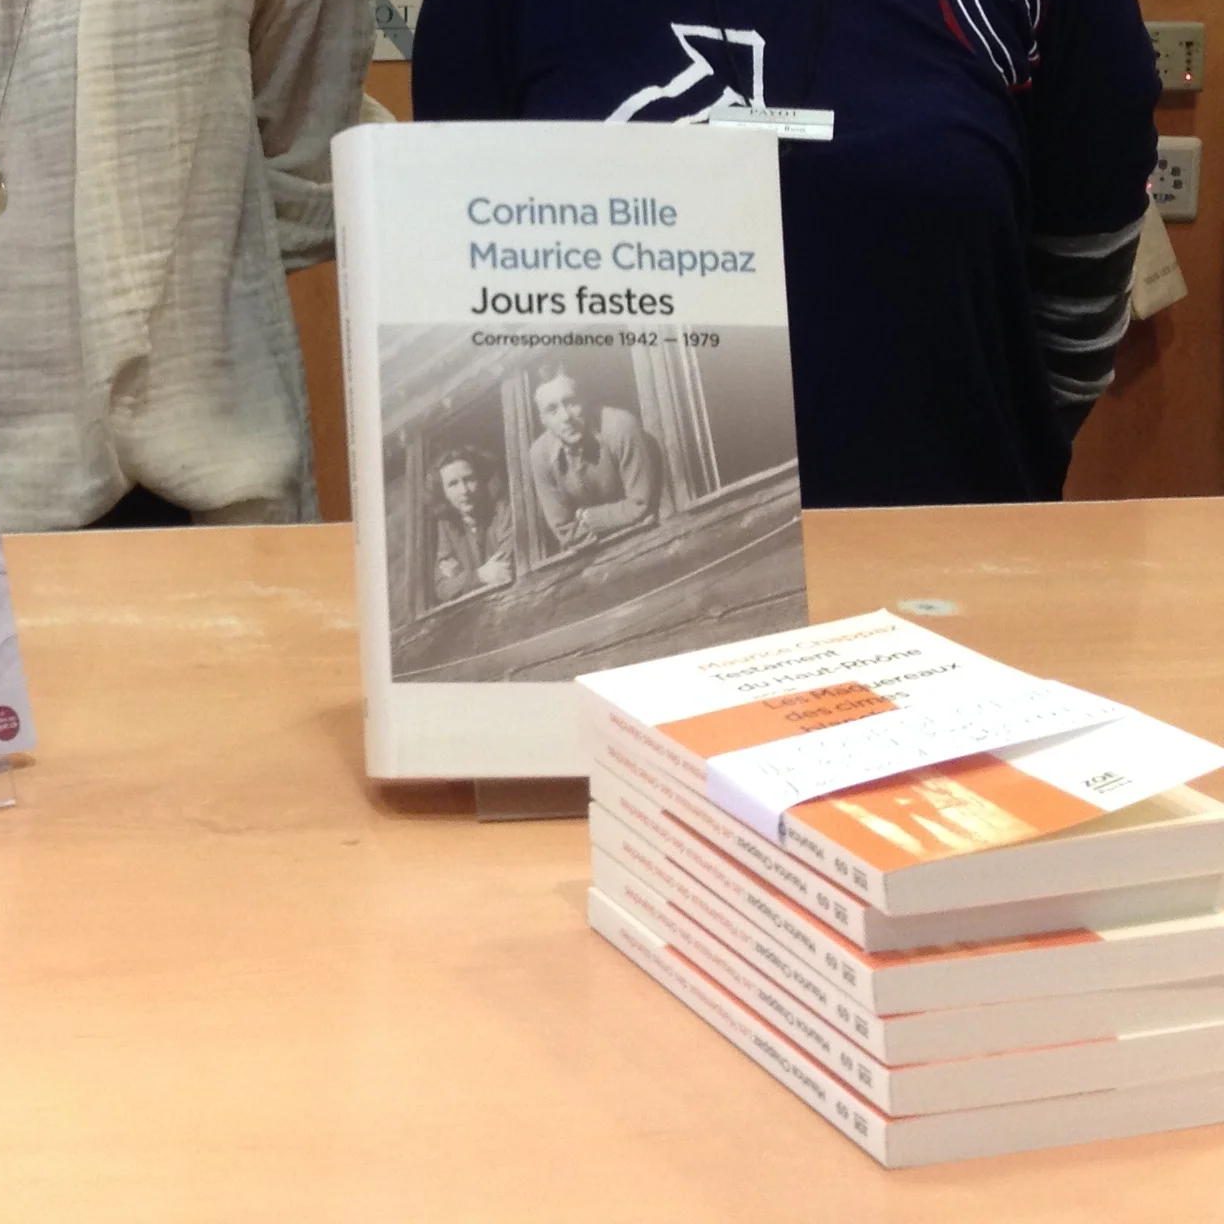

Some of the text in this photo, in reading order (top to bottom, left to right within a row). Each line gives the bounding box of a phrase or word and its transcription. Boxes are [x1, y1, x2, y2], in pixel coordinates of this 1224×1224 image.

[468, 197, 677, 226] Corinna Bille
[469, 242, 756, 277] Maurice Chappaz
[471, 286, 675, 316] Jours fastes
[471, 331, 614, 349] Correspondance
[620, 332, 658, 347] 1942
[683, 332, 720, 348] 1979
[709, 648, 842, 682] Testament
[737, 679, 770, 693] du
[775, 646, 923, 684] Haut-Rhône
[762, 694, 810, 710] Les
[808, 661, 962, 701] Maquereaux
[784, 706, 832, 723] des
[836, 689, 910, 712] cimes
